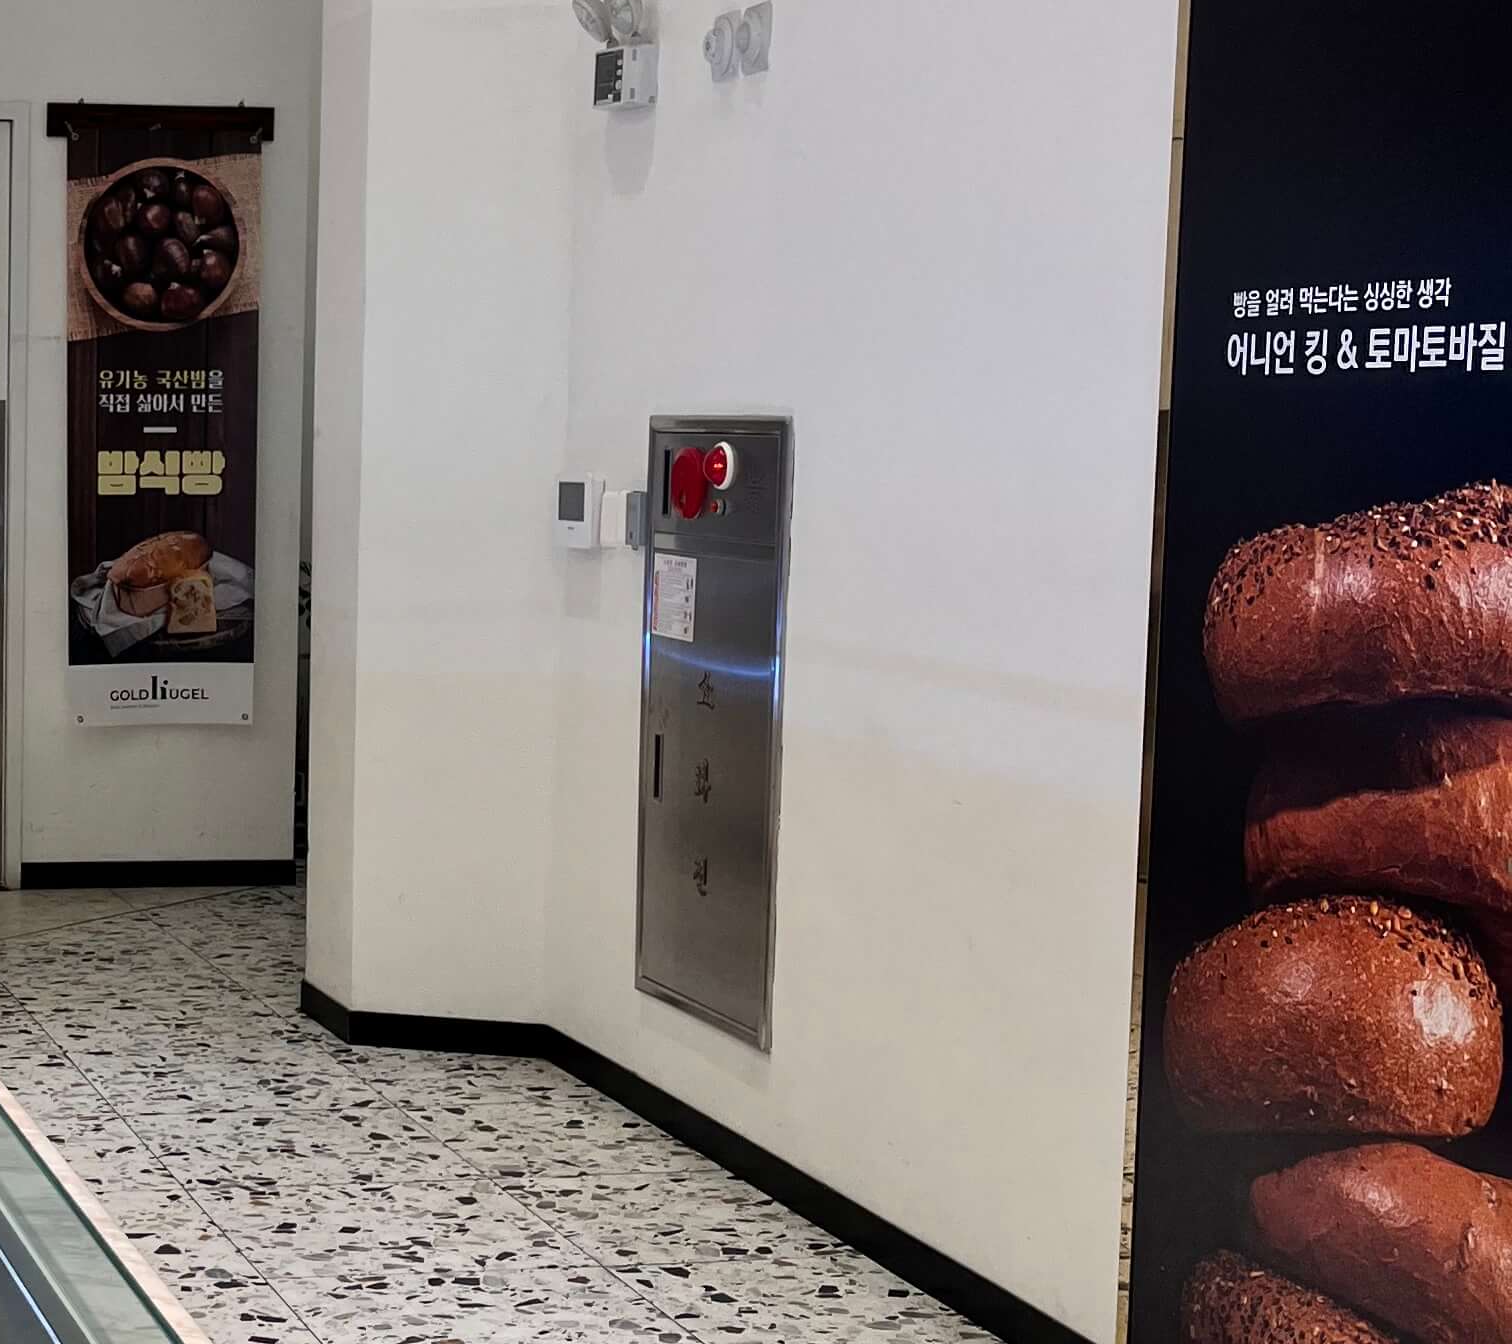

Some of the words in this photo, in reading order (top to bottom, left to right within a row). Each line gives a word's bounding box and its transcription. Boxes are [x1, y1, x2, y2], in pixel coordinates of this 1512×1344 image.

[1233, 289, 1262, 318] 빵을
[1265, 287, 1294, 316] 얼려
[1299, 283, 1359, 315] 먹는다는
[1363, 279, 1413, 312] 싱싱한
[1416, 277, 1452, 308] 생각
[1227, 329, 1296, 376] 어니언
[1304, 328, 1329, 376] 킹
[1336, 328, 1359, 370] &
[1364, 321, 1506, 374] 토마토바질
[98, 369, 149, 390] 유기농
[155, 369, 225, 390] 국산밤을
[98, 393, 130, 413] 직접
[136, 393, 185, 413] 삶아서
[191, 393, 224, 413] 만든
[97, 450, 226, 496] 밤식빵
